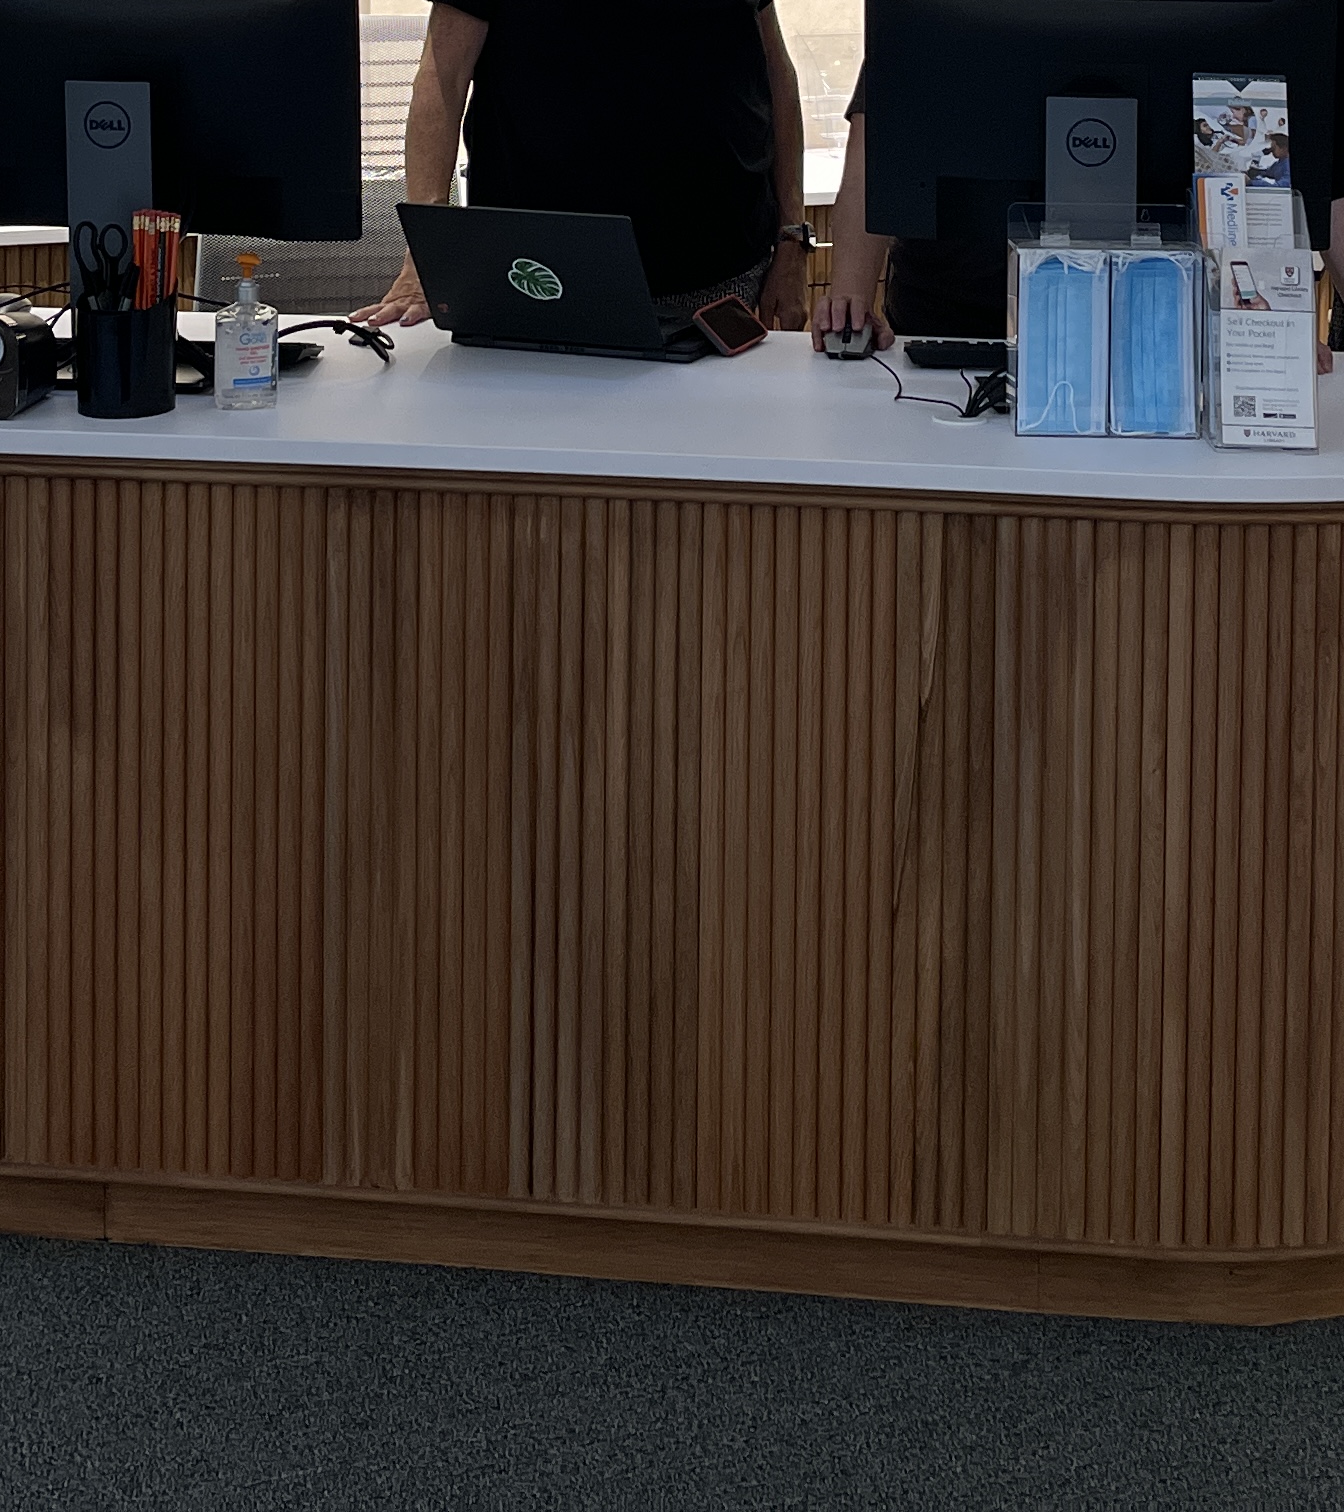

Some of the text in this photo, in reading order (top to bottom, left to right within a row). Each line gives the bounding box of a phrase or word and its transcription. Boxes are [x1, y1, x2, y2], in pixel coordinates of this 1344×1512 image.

[89, 119, 126, 131] DELL
[1072, 136, 1111, 149] DELL
[1245, 318, 1285, 328] Checkout
[1226, 329, 1276, 340] Your Pocket
[1252, 430, 1297, 439] HARVARD
